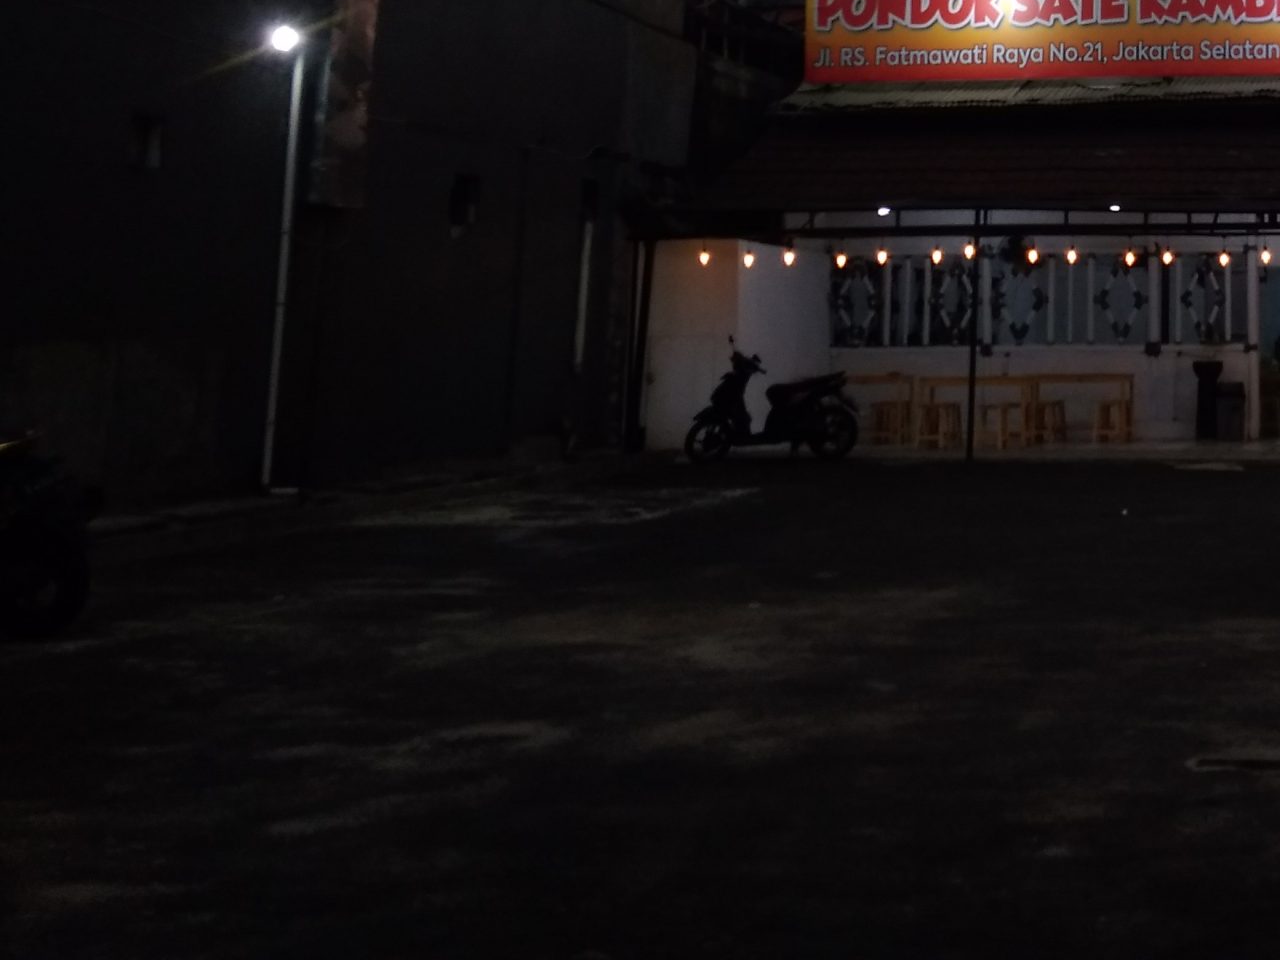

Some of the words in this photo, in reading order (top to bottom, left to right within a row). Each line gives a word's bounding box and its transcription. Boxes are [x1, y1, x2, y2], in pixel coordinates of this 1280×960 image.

[840, 47, 869, 66] RS.
[875, 43, 988, 66] Fatmawati
[992, 43, 1044, 68] Raya
[1049, 41, 1108, 64] No.21,
[1112, 40, 1194, 61] Jakarta
[1199, 39, 1280, 60] Selatan
